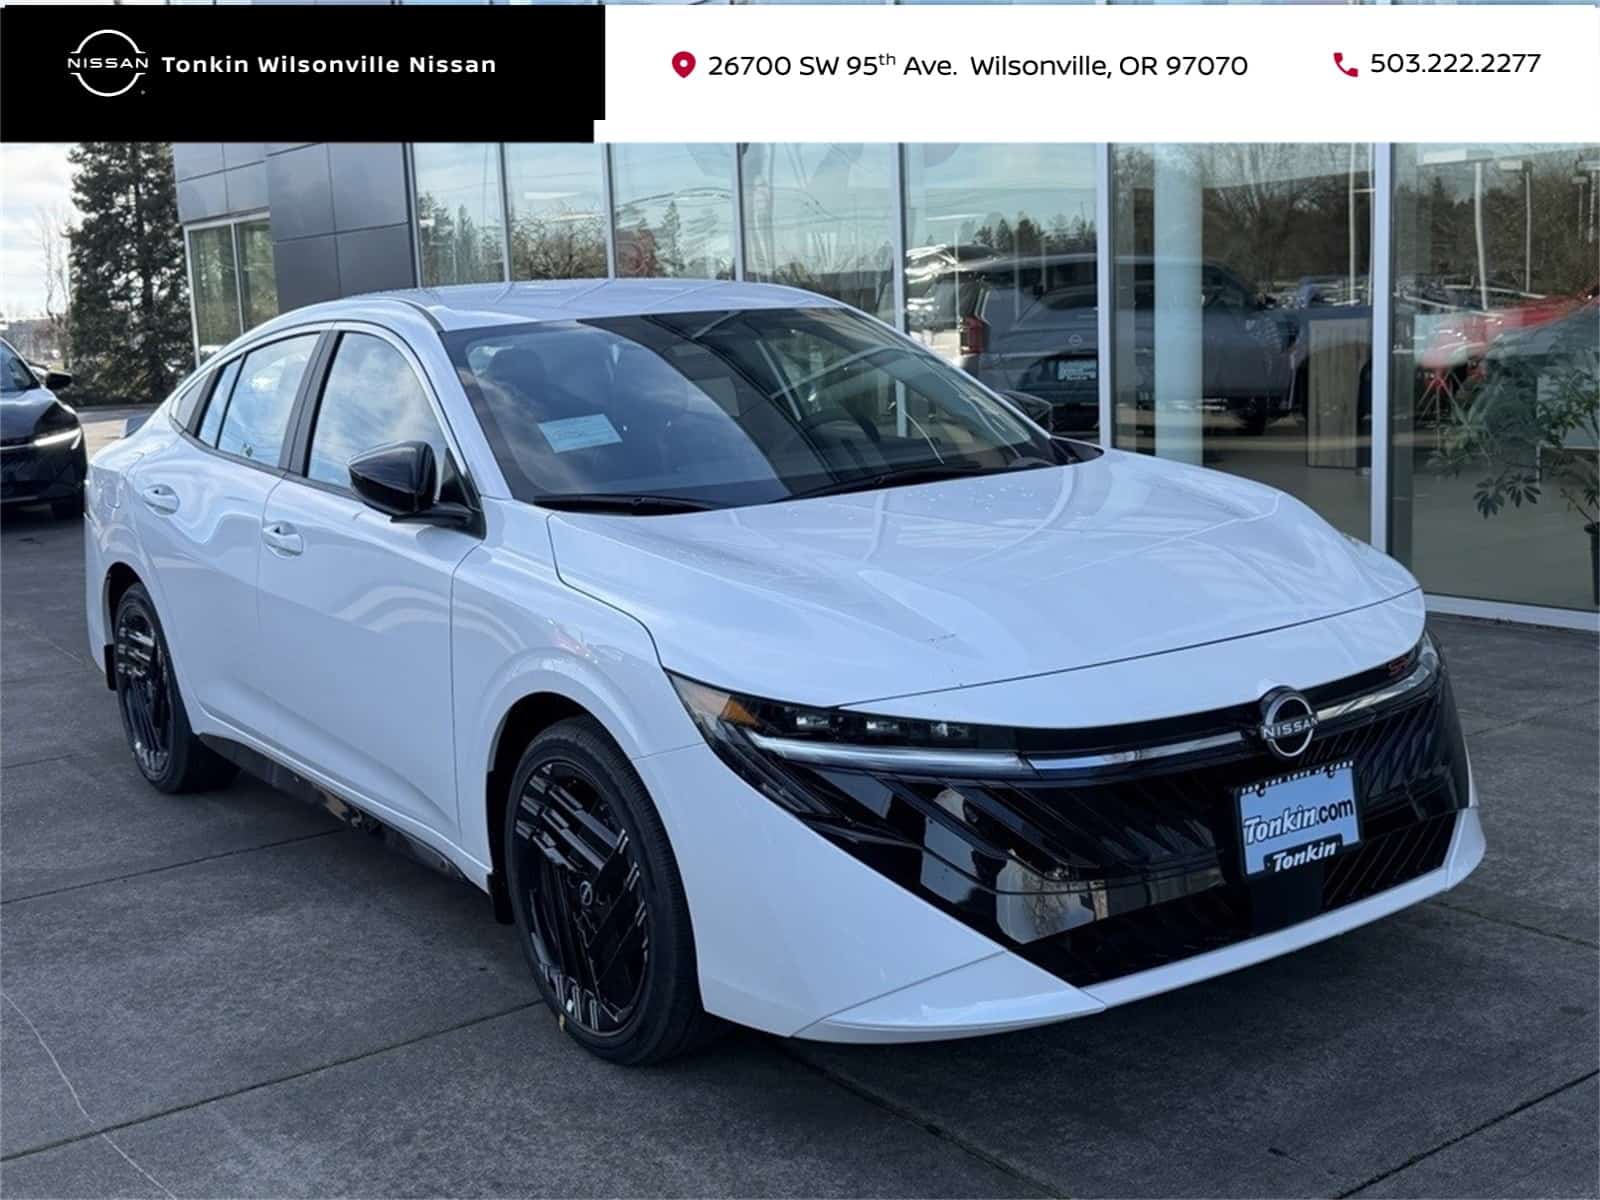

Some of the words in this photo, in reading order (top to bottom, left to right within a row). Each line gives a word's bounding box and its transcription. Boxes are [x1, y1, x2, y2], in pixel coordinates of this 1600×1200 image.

[1261, 717, 1319, 740] NISSAN
[1242, 799, 1354, 846] Tonkin.com
[1272, 842, 1337, 873] Tonkin
